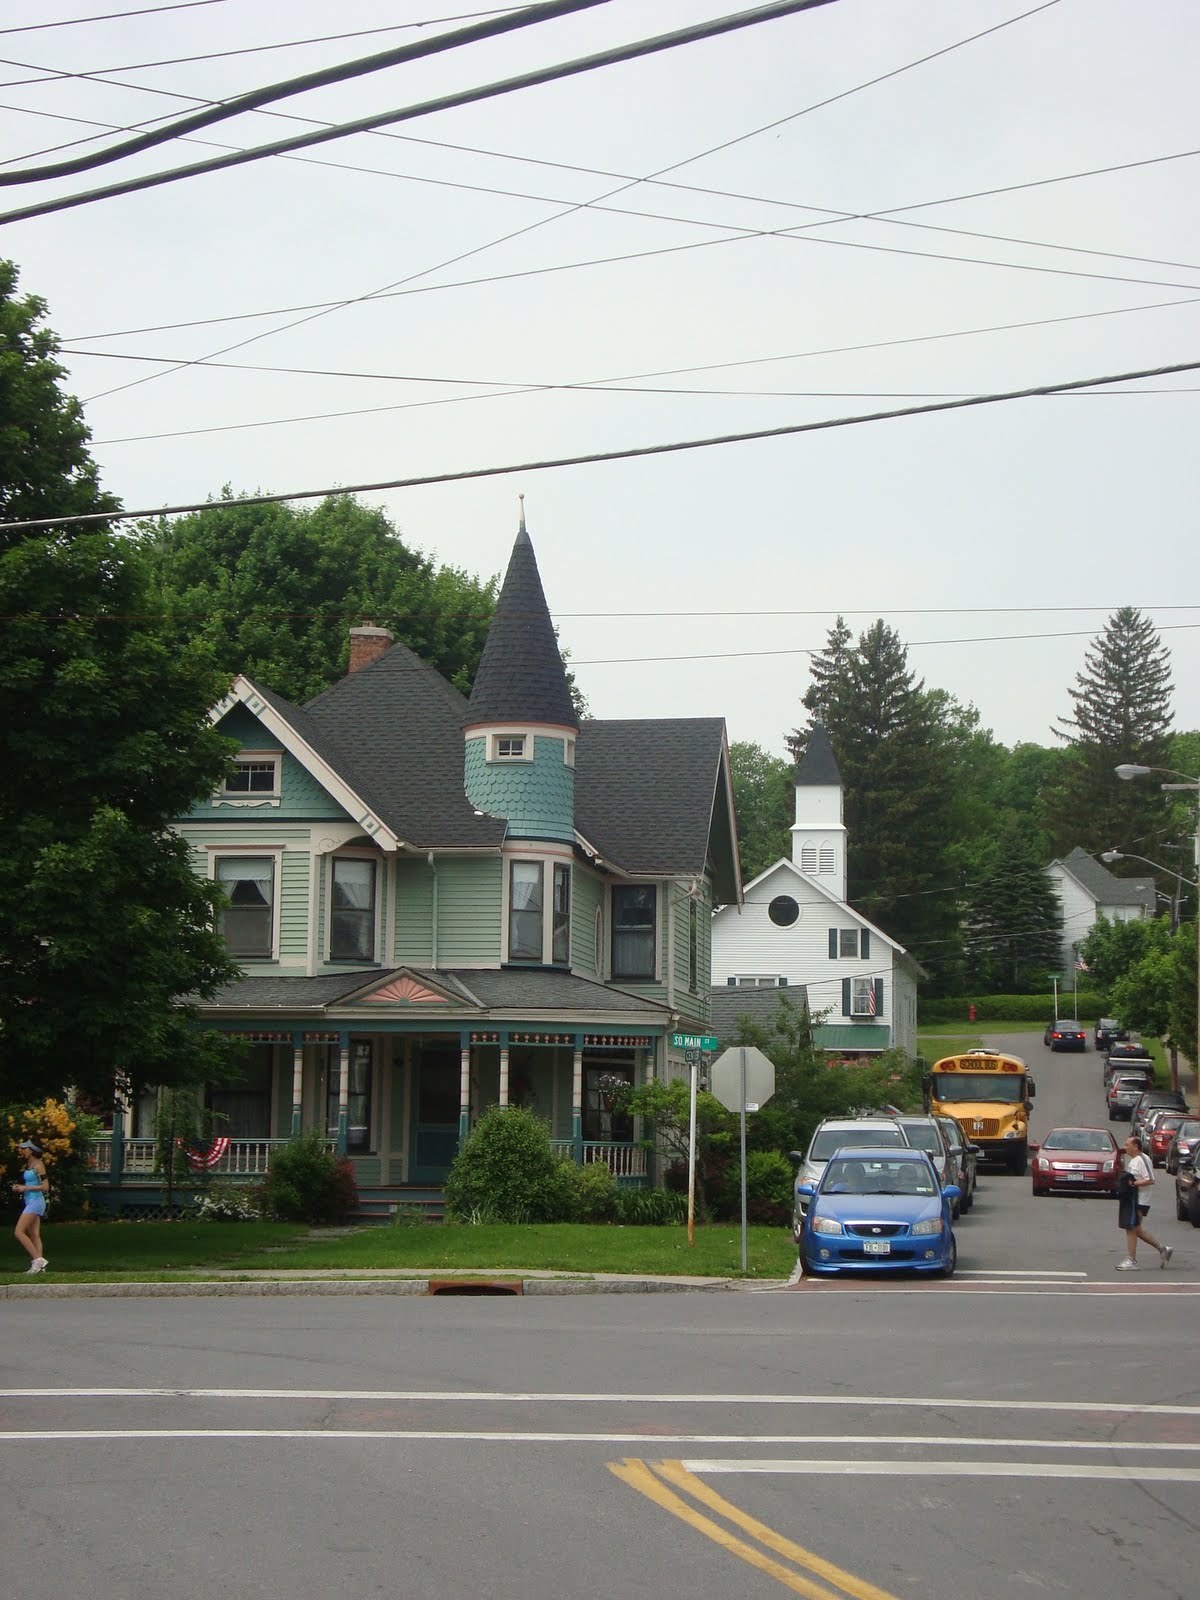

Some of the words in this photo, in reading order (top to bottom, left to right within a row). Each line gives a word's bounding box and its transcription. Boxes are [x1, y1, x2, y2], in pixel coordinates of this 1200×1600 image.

[674, 1036, 683, 1046] SO
[684, 1037, 701, 1048] MAIN
[960, 1060, 984, 1070] SCHOOL
[985, 1060, 998, 1070] BUS
